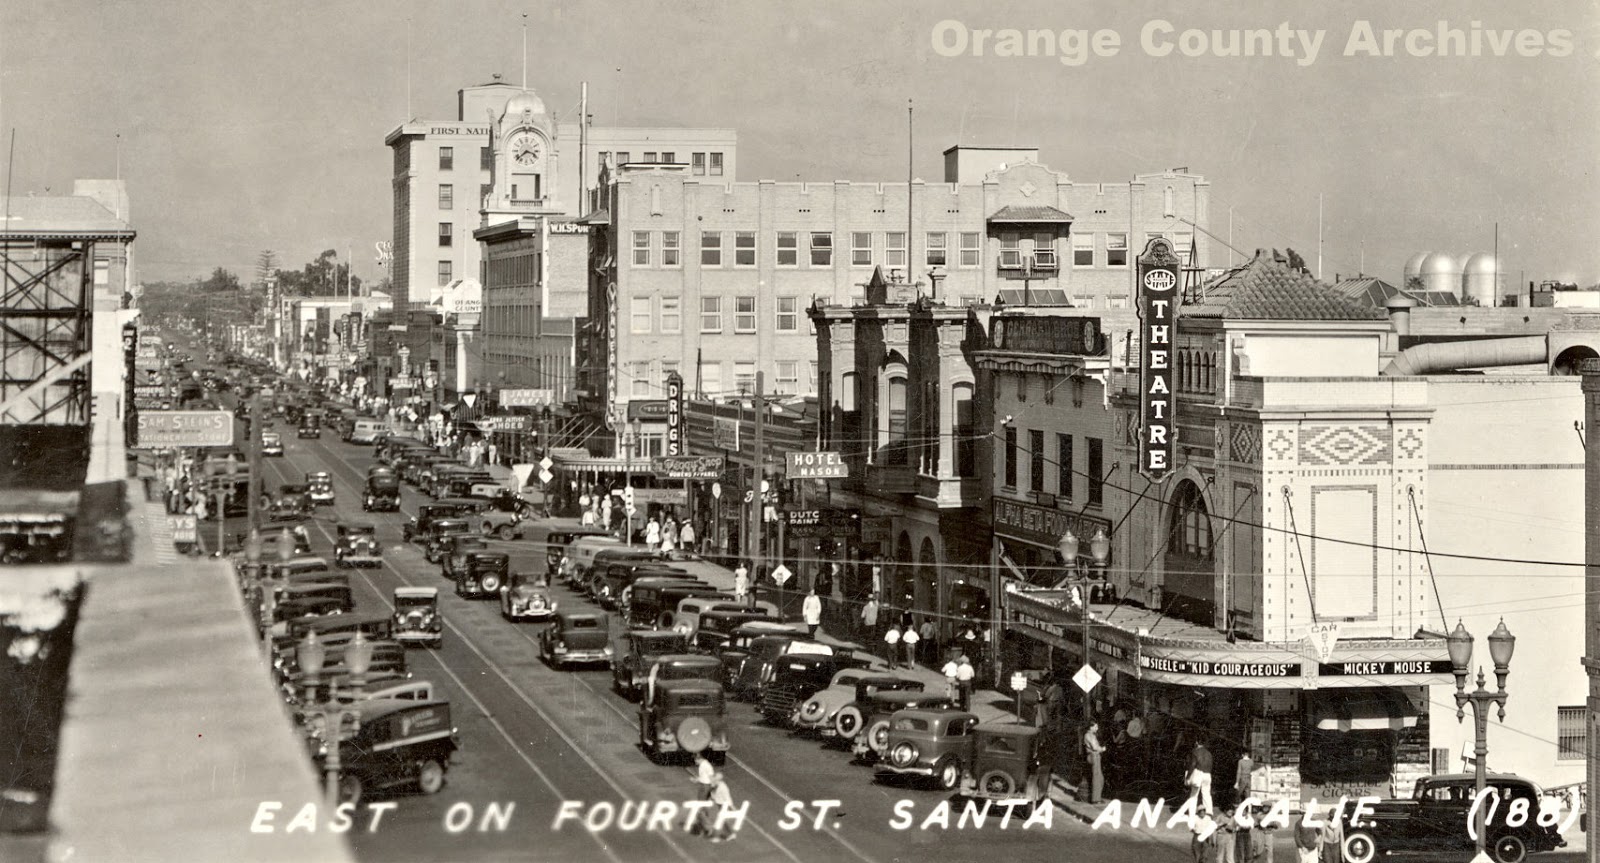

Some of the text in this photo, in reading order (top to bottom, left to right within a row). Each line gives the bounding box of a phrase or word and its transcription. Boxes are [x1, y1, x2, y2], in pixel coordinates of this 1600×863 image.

[1145, 271, 1175, 289] STATE
[1148, 299, 1169, 469] THEATRE
[510, 390, 544, 398] JAMES
[138, 415, 223, 429] SAM STEIN'S
[669, 384, 678, 456] DRUGS
[794, 454, 844, 466] HOTEL
[801, 467, 840, 476] MASON
[995, 501, 1022, 528] ALPHA
[1022, 507, 1045, 533] BETA
[1311, 624, 1338, 634] CAR
[1321, 633, 1329, 659] STOP
[1150, 658, 1178, 672] STEELE
[1214, 663, 1294, 676] COURAGEOUS"
[1344, 662, 1432, 675] MICKEY MOUSE
[1322, 788, 1372, 798] CIGARS
